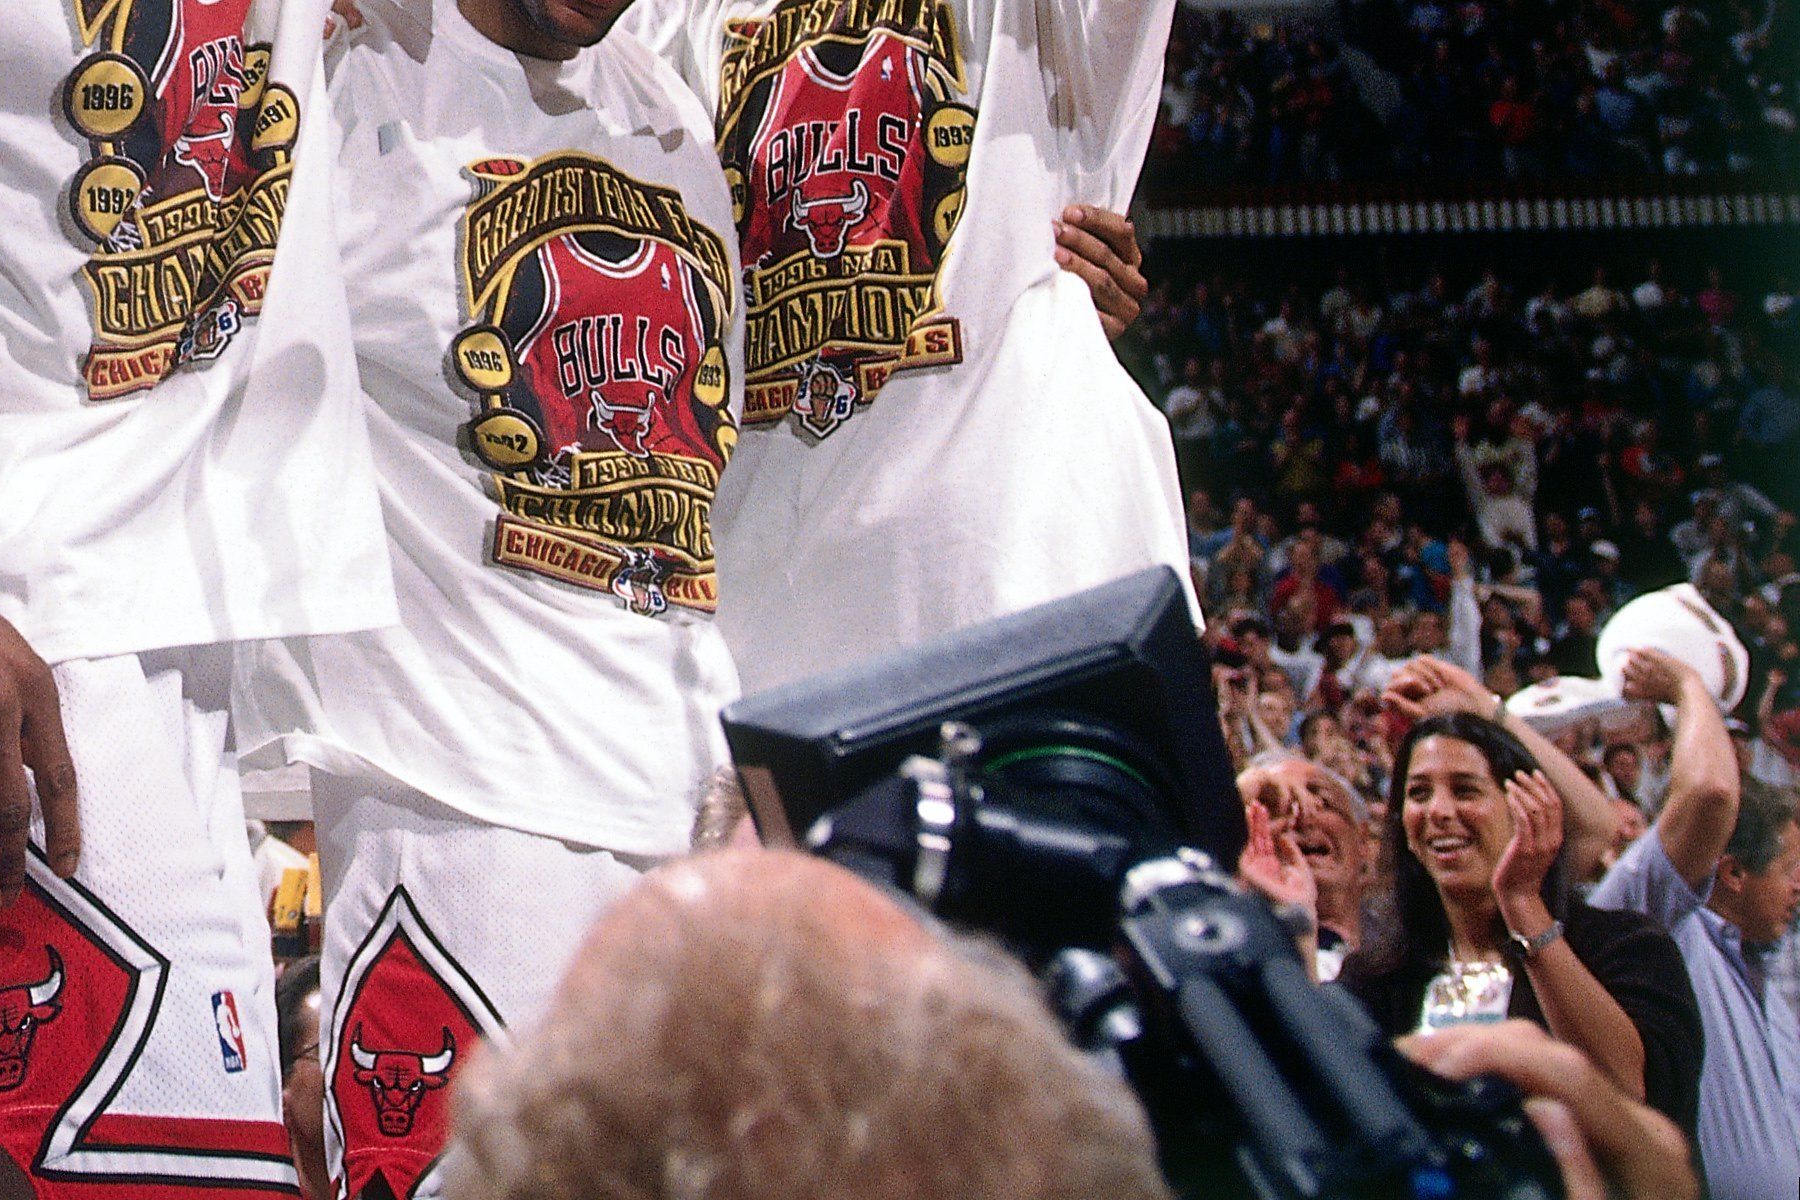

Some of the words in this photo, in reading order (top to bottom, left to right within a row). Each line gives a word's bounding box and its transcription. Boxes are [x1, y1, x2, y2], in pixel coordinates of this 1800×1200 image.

[82, 83, 135, 111] 1996
[766, 108, 909, 209] BULLS
[473, 166, 585, 280] GREATEST
[590, 169, 662, 232] TEAM
[463, 349, 504, 373] 1996
[553, 313, 686, 403] BULLS
[582, 453, 650, 486] 1996
[505, 528, 614, 580] CHICAGO
